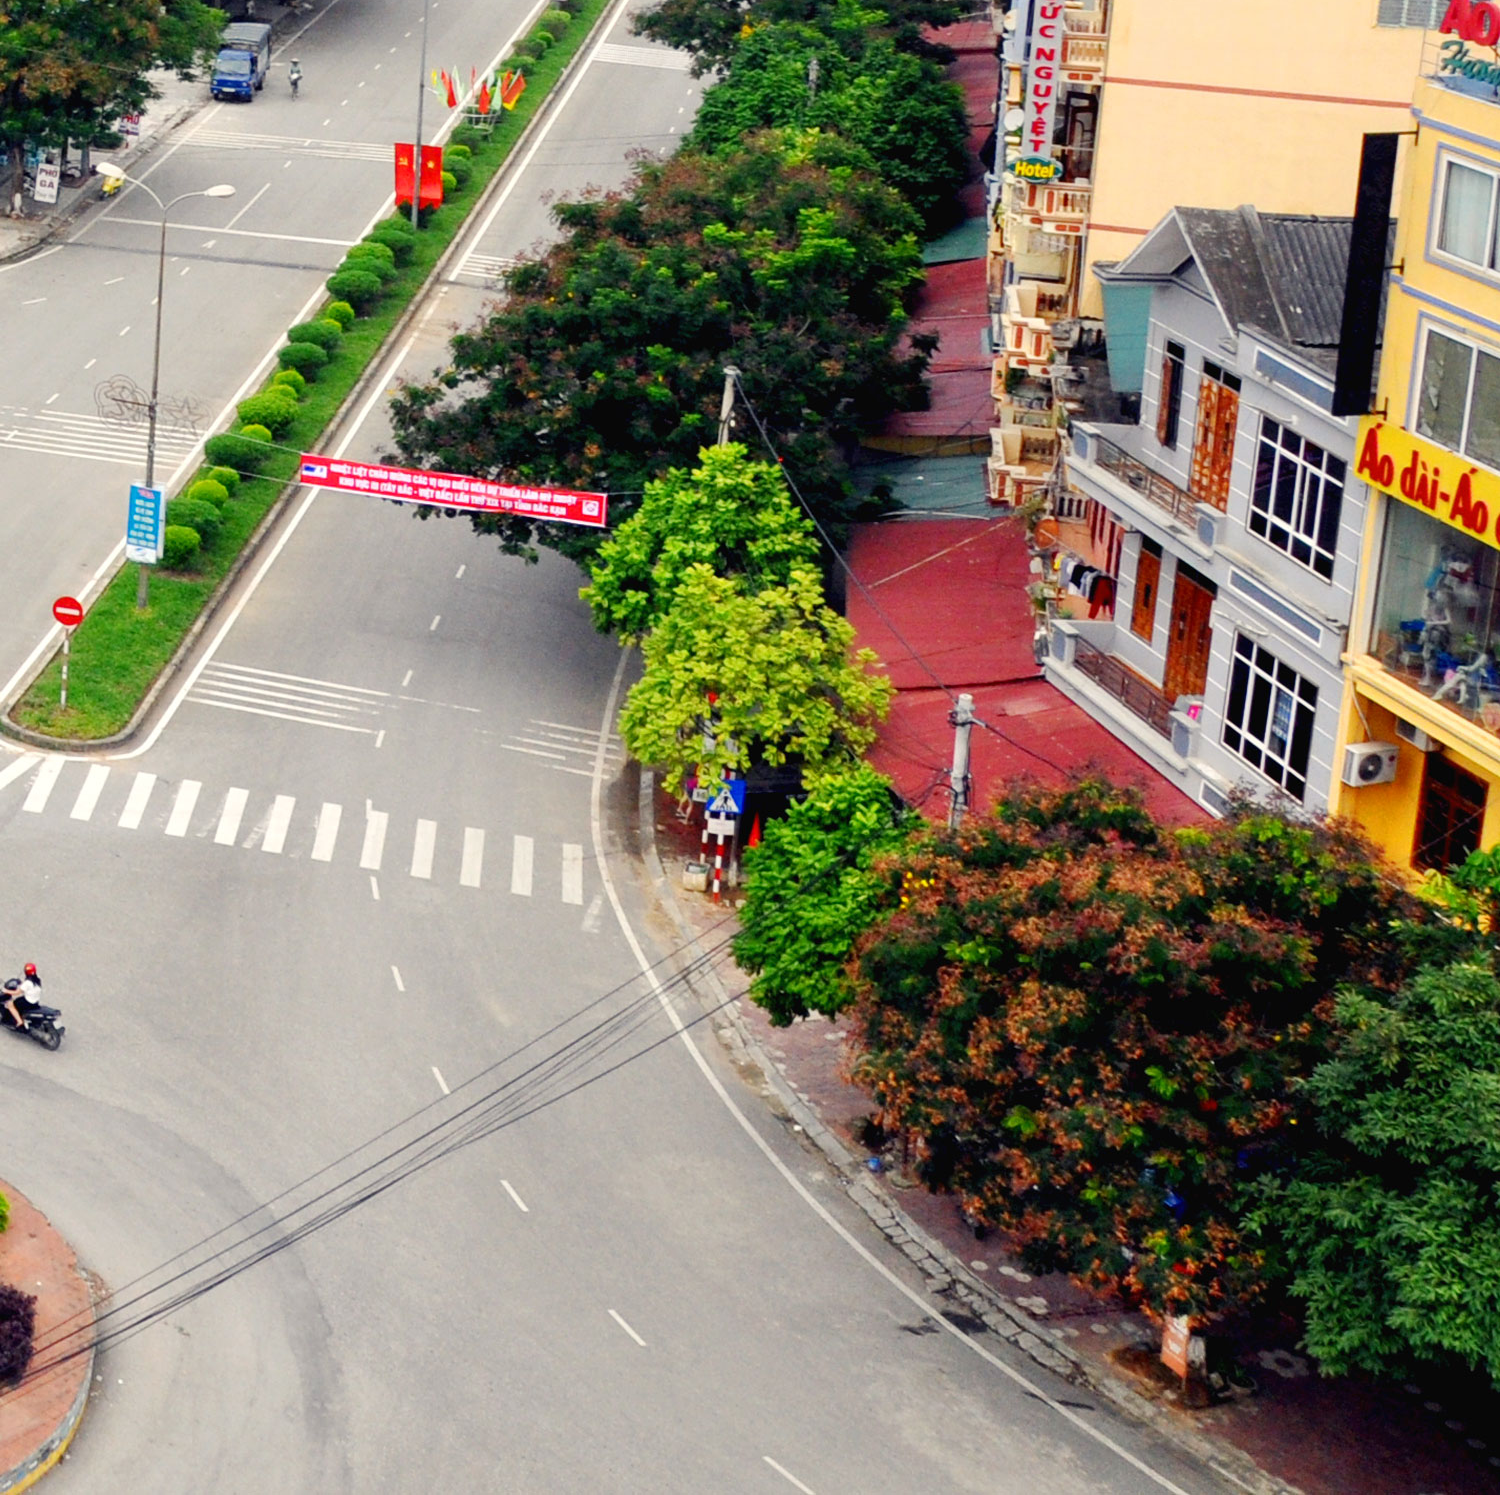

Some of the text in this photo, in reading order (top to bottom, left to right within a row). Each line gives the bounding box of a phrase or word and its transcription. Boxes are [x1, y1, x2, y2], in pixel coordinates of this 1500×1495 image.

[1029, 48, 1055, 152] NGUYỆT
[1014, 161, 1055, 179] Hotel
[1357, 422, 1395, 487] Áo
